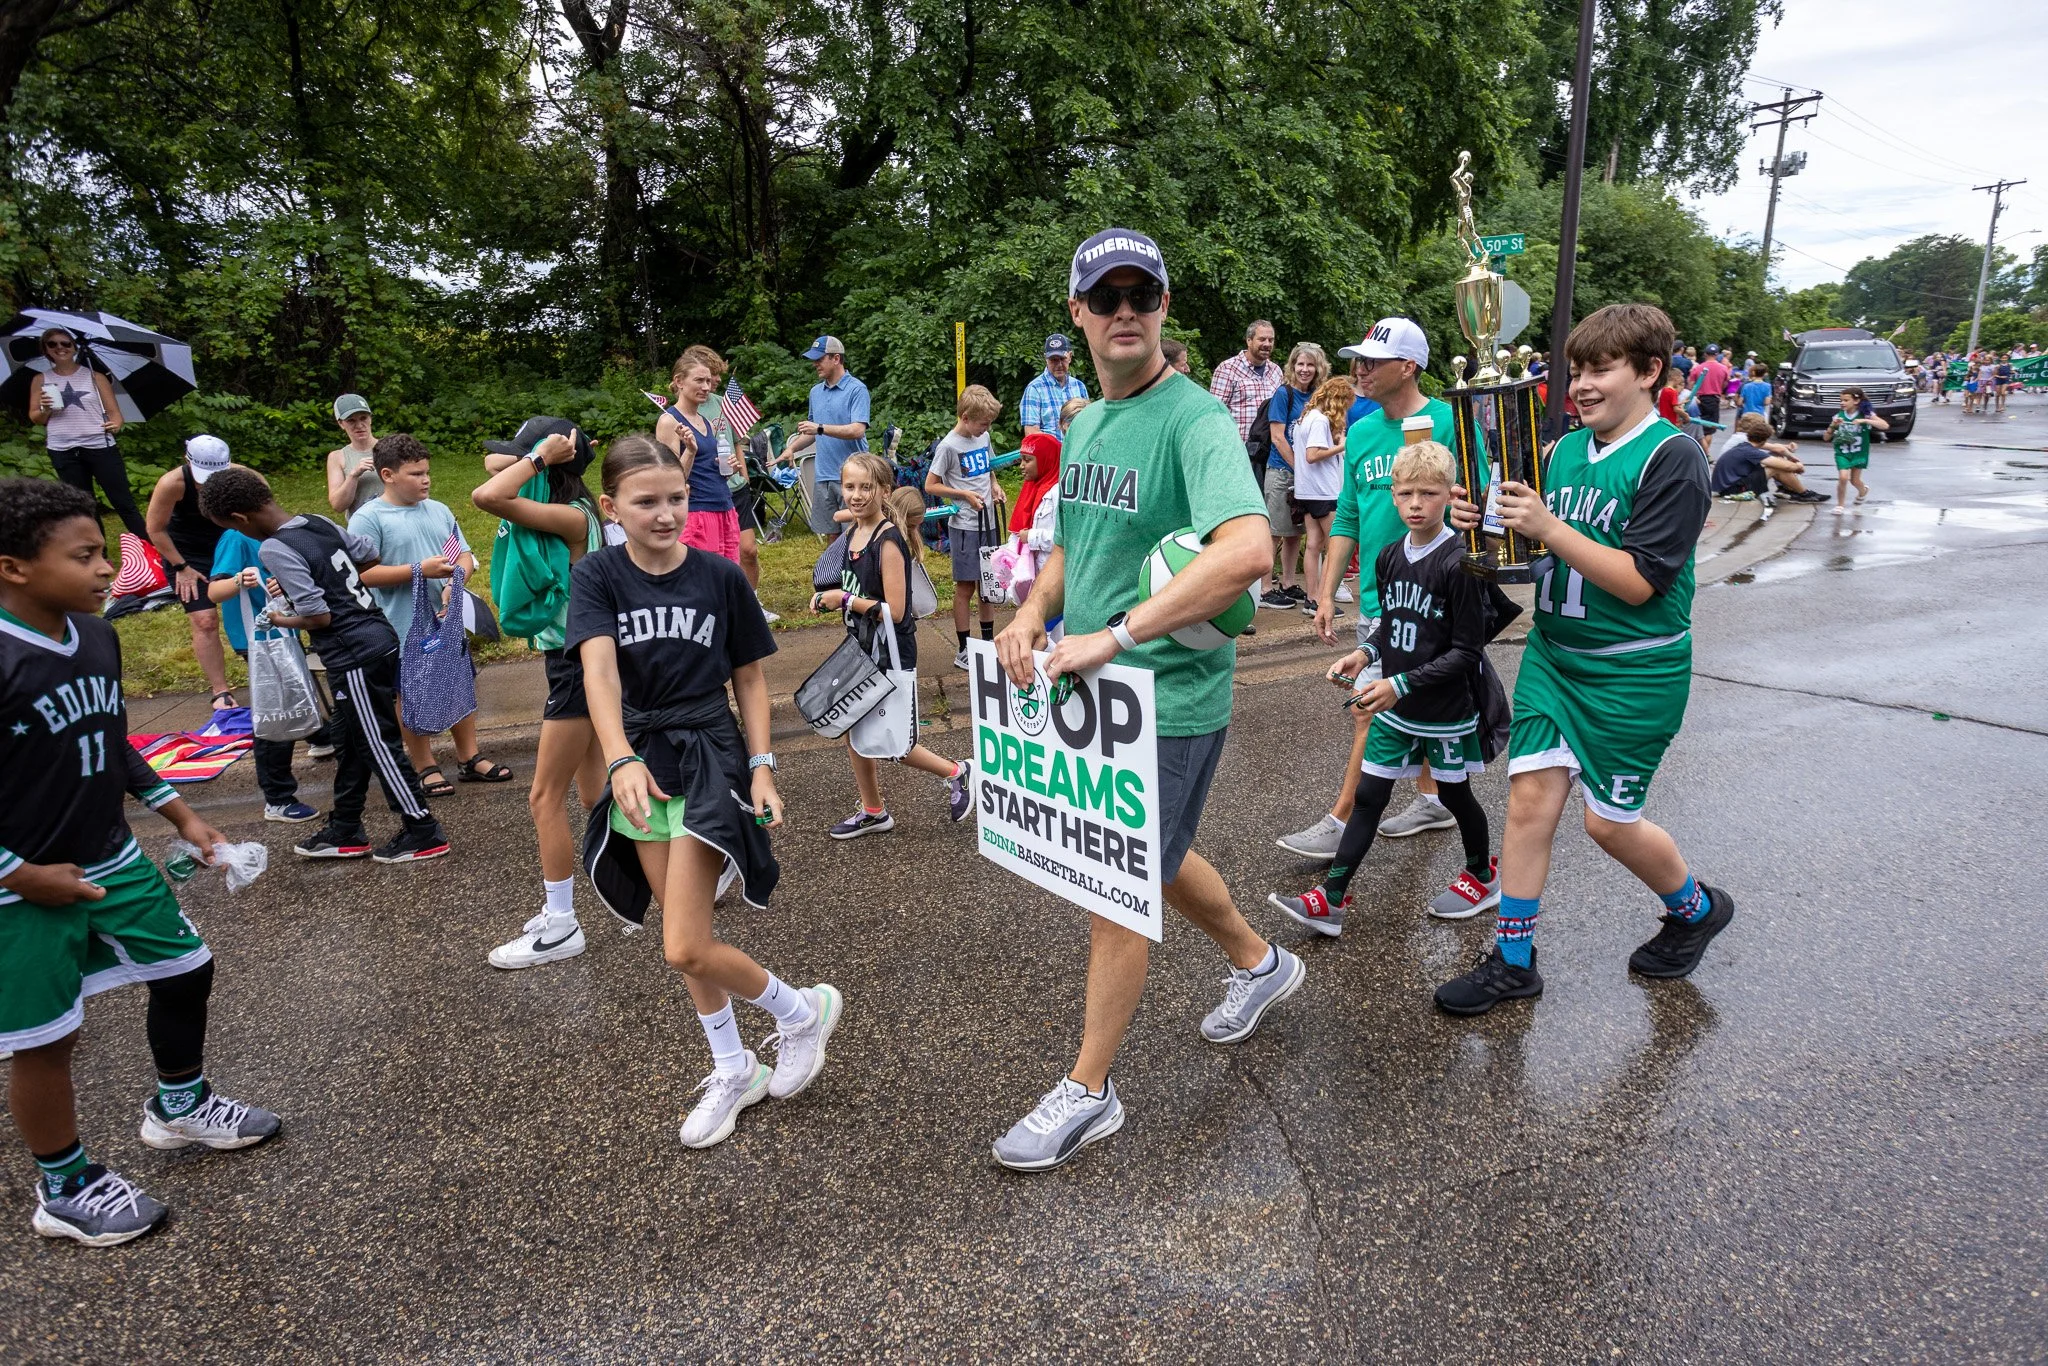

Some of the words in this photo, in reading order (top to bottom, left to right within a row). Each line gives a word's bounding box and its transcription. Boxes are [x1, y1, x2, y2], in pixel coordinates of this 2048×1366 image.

[1486, 239, 1509, 253] 50th
[1510, 237, 1524, 250] St
[1546, 485, 1619, 533] EDINA
[330, 548, 373, 610] 2
[1385, 581, 1433, 619] EDINA
[617, 606, 716, 648] EDINA
[1390, 618, 1417, 653] 30
[32, 676, 119, 735] EDINA
[809, 676, 878, 730] lululem
[78, 730, 105, 777] 11
[1438, 736, 1464, 764] E
[979, 724, 1147, 829] DREAMS
[1609, 774, 1640, 804] E
[981, 779, 1057, 842] START
[1060, 811, 1149, 881] HERE
[982, 826, 1150, 917] EDINABASKETBALL.COM
[1454, 876, 1482, 901] idas
[1303, 891, 1321, 915] das
